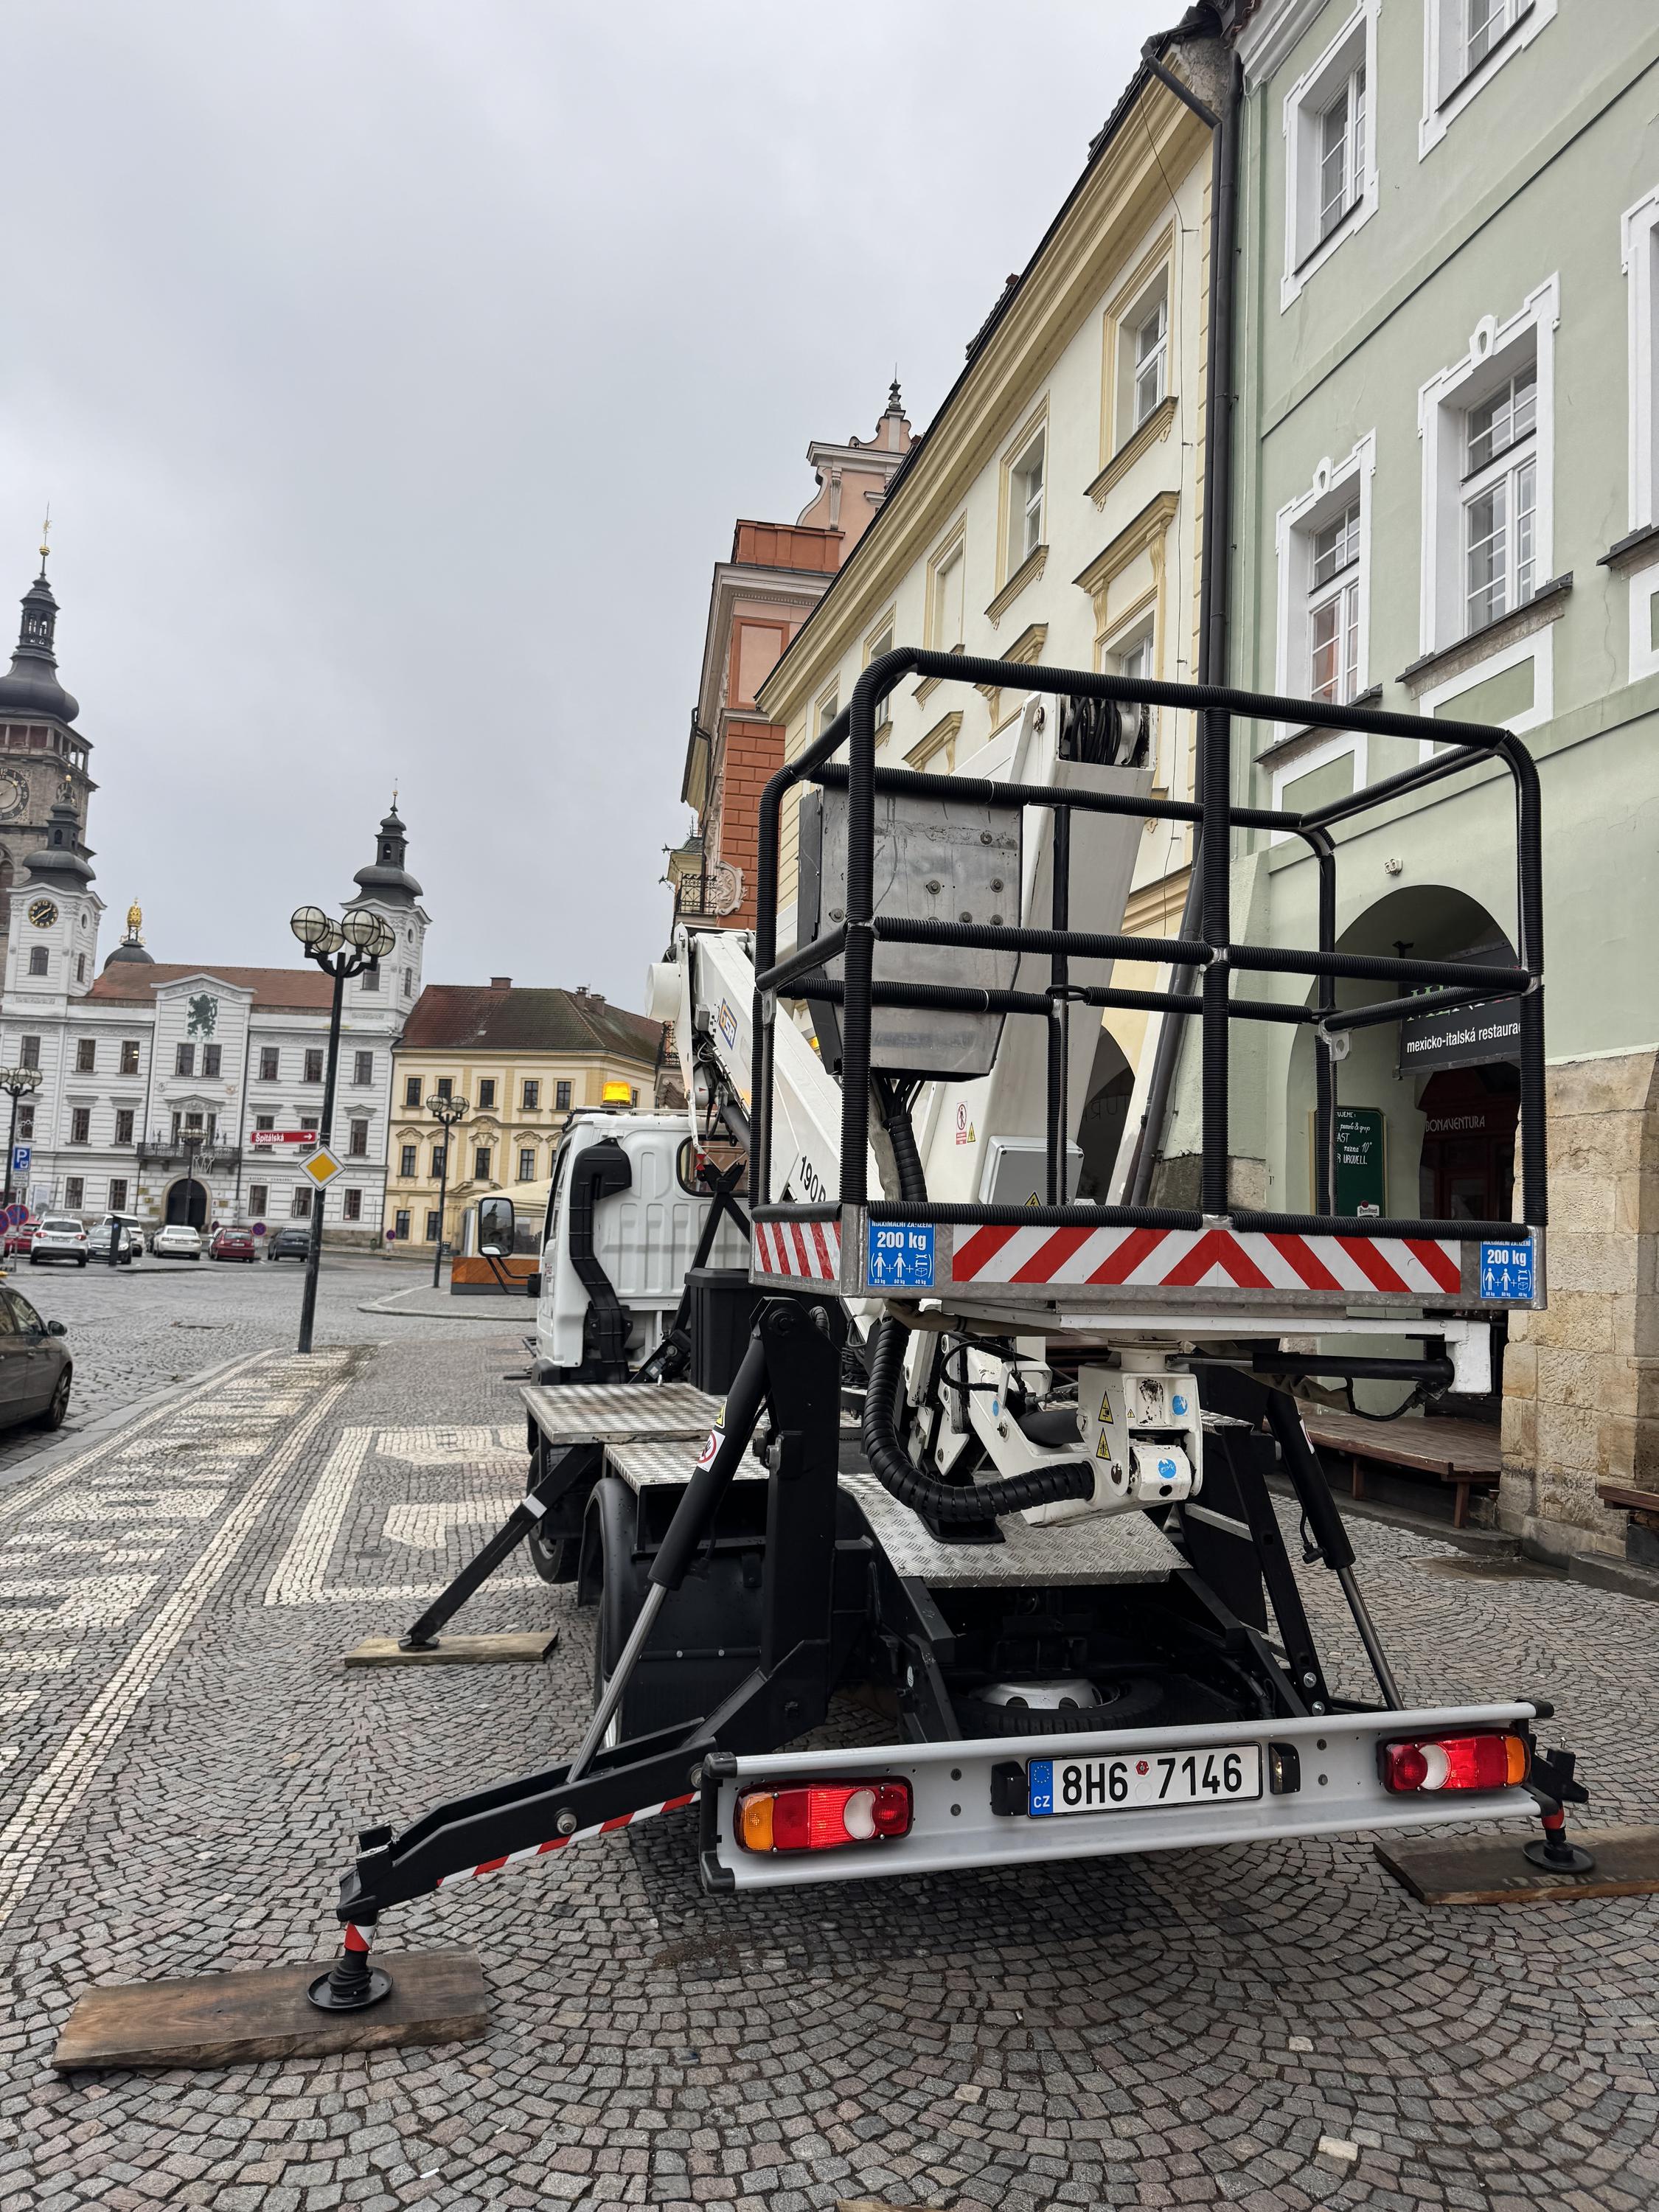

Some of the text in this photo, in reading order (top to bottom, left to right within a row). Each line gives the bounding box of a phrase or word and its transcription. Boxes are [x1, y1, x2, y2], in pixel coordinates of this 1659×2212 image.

[1406, 1027, 1476, 1054] mexicko-italská
[1354, 1121, 1358, 1130] &
[1425, 1115, 1485, 1132] BONAVENTURA
[255, 1132, 285, 1143] Špitálská
[16, 1149, 27, 1163] P
[877, 1231, 926, 1251] 200 kg
[1487, 1249, 1526, 1267] 200 kg
[1033, 1752, 1242, 1809] CZ 8H6 7146
